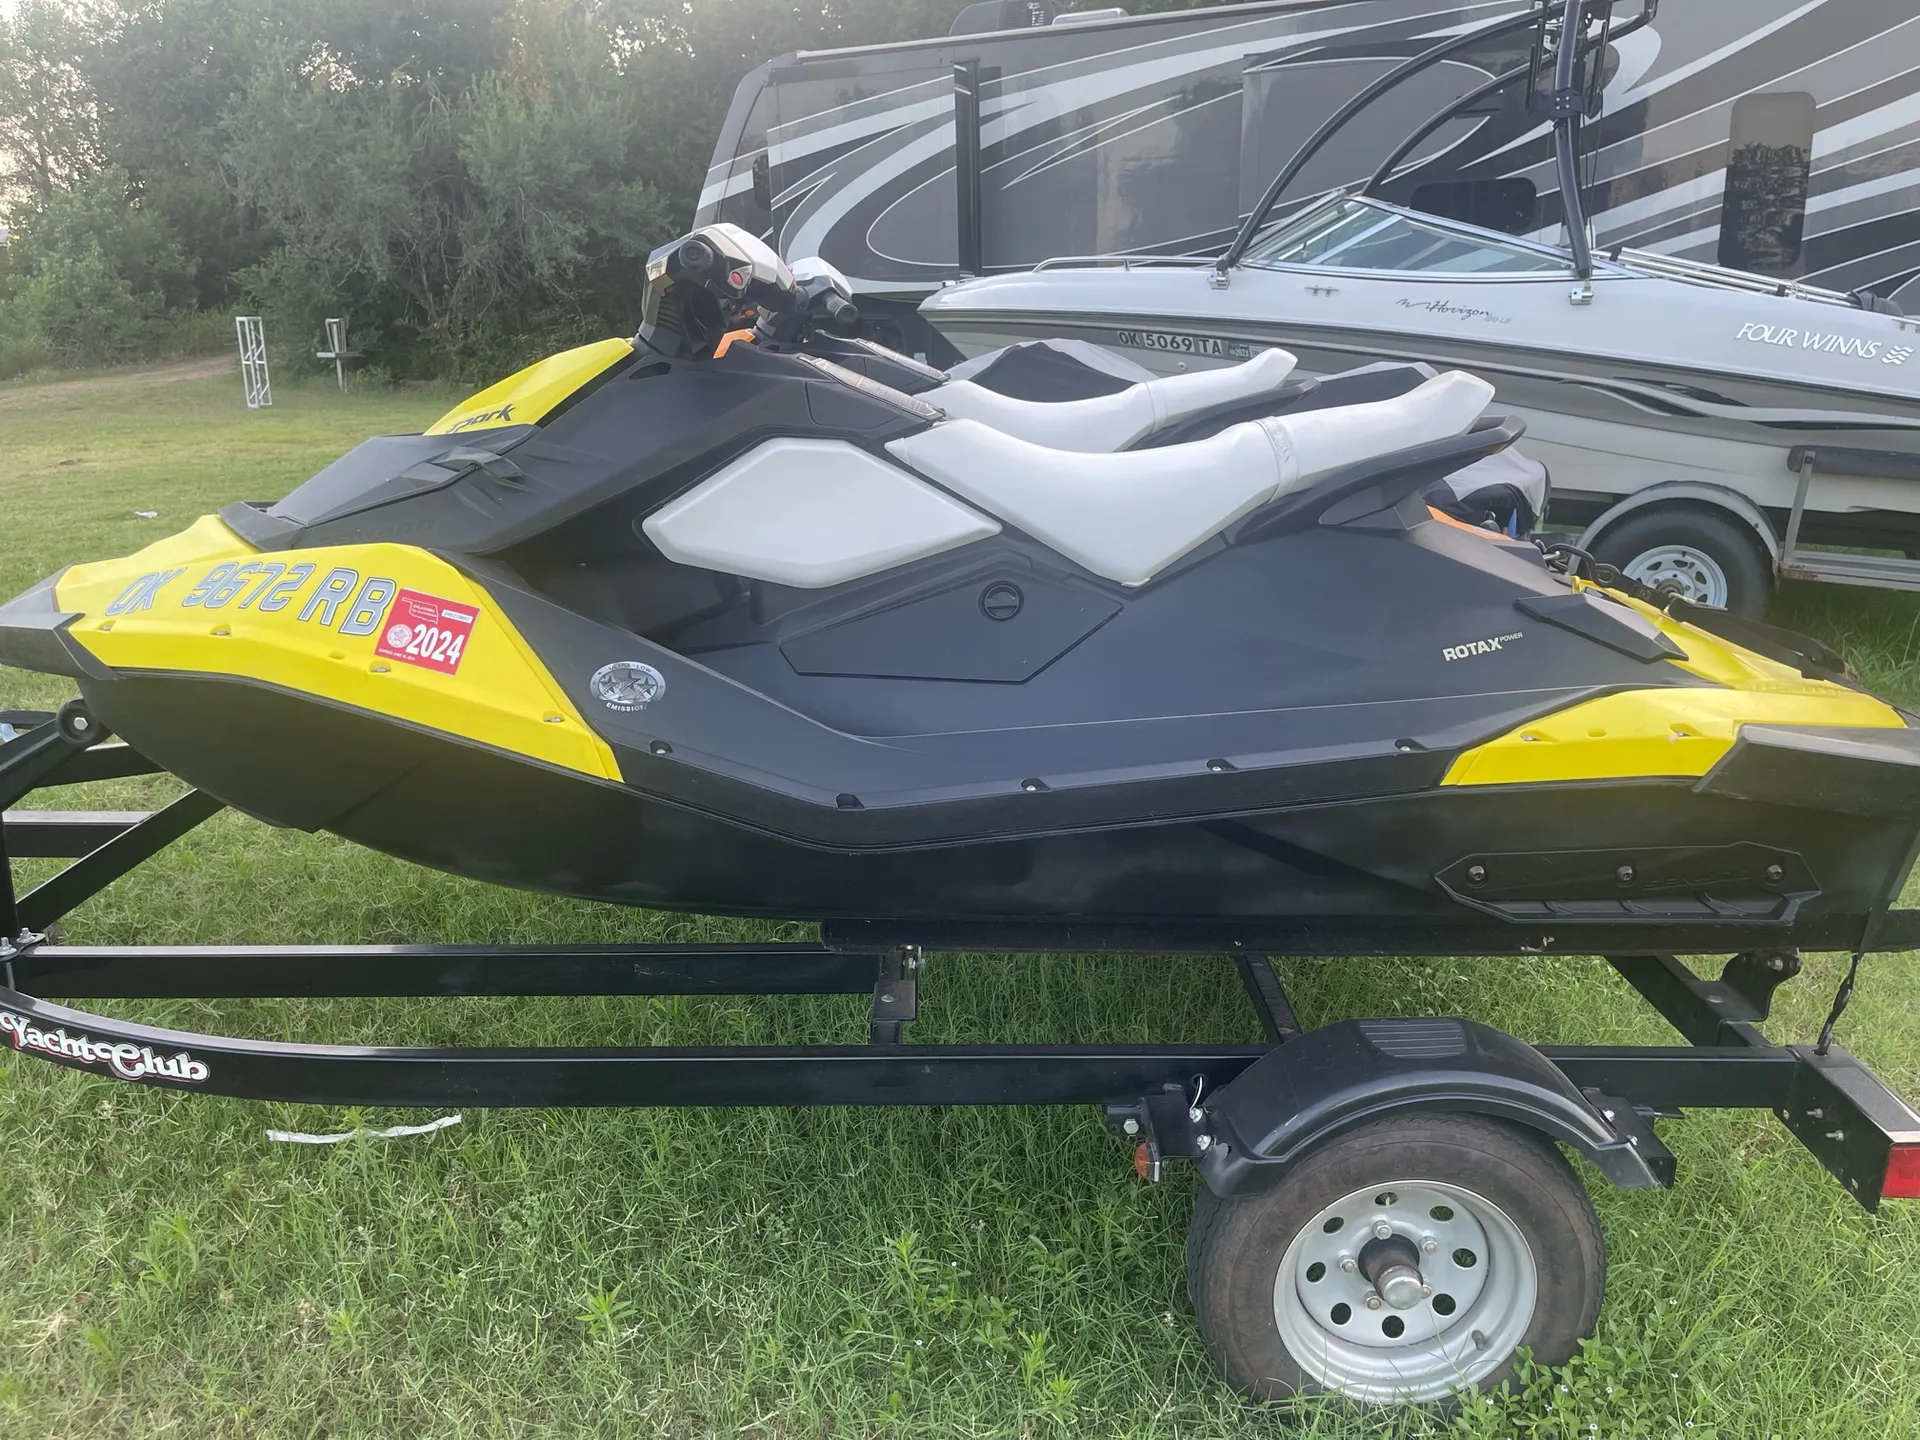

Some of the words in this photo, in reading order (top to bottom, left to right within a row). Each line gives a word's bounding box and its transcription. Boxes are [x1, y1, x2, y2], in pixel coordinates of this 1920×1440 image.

[1425, 300, 1490, 321] Horizon
[1118, 331, 1140, 346] OK
[1146, 333, 1193, 351] 5069
[1198, 338, 1222, 355] TA
[1735, 322, 1798, 347] FOUR
[1801, 331, 1882, 359] WINNS
[445, 403, 517, 434] park
[104, 567, 187, 617] OK
[181, 561, 316, 613] 9672
[296, 567, 397, 637] RB
[405, 623, 465, 665] 2024
[1442, 637, 1503, 661] ROTAX
[1500, 632, 1523, 643] POWER
[0, 1011, 98, 1063] Yacht
[100, 1041, 209, 1081] Club
